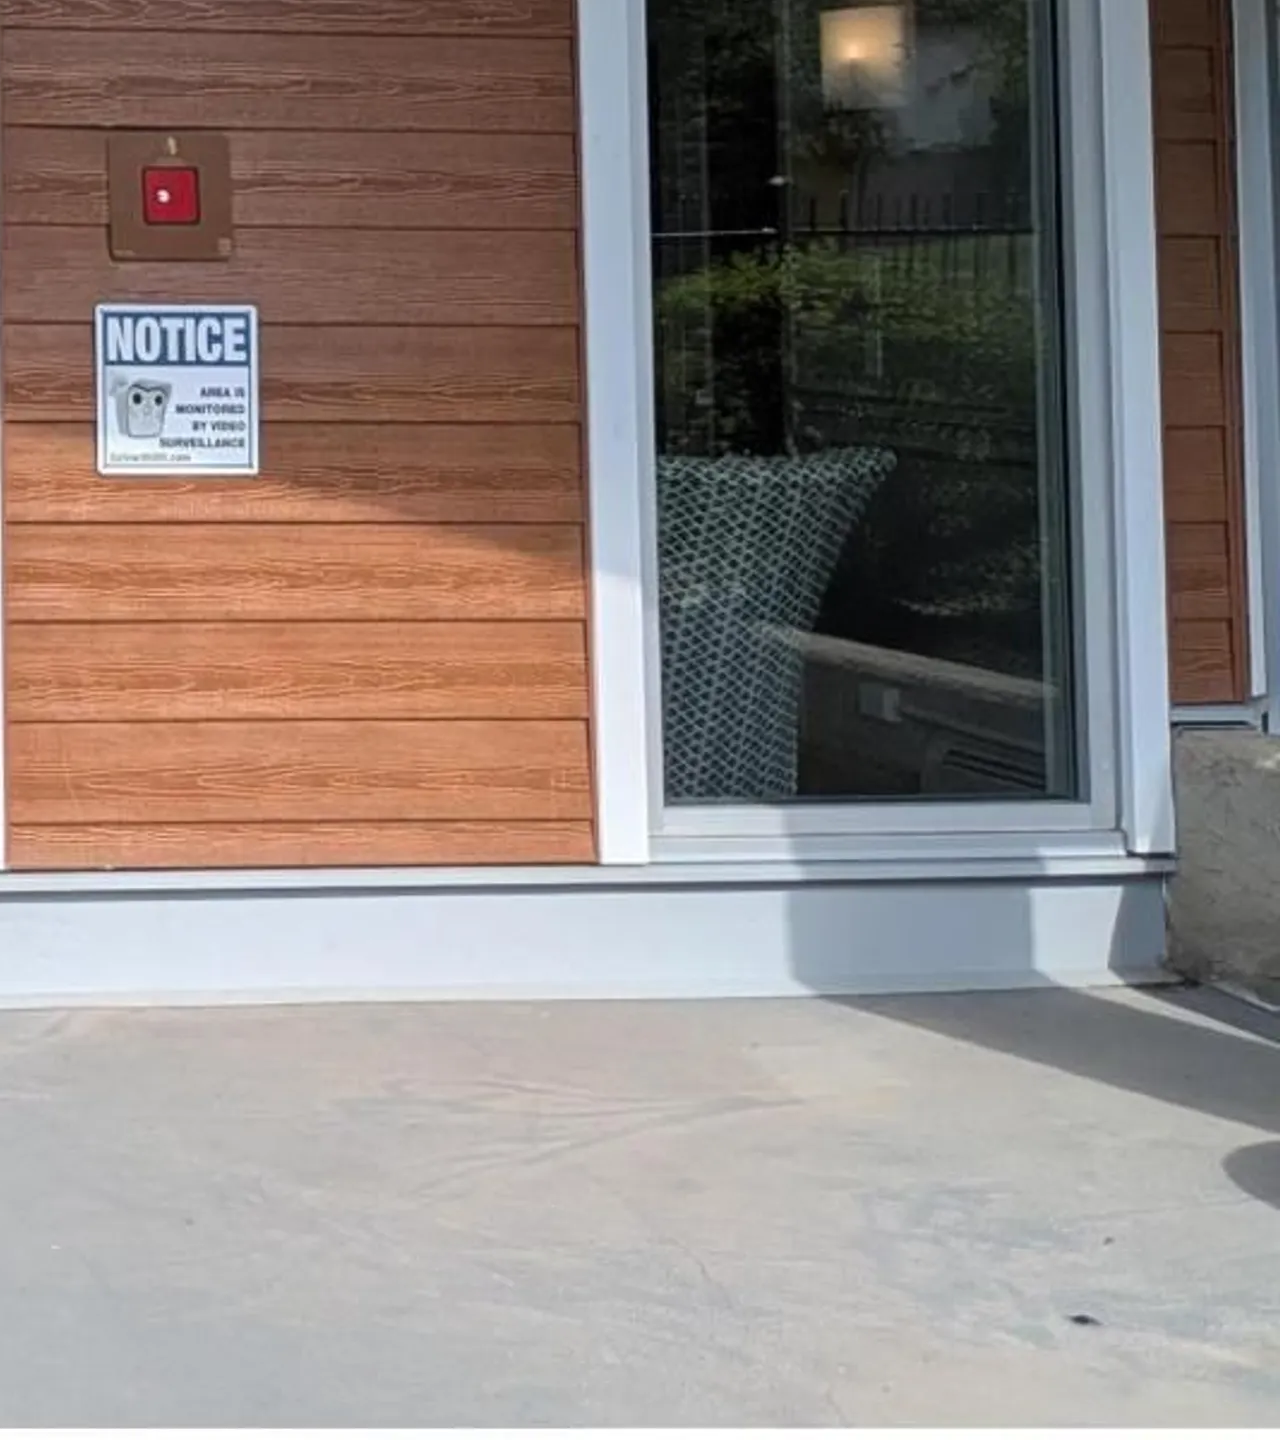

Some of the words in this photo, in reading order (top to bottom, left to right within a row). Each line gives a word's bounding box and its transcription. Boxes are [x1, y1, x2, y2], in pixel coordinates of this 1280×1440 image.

[106, 316, 248, 362] NOTICE
[175, 404, 245, 414] MONITORED
[211, 421, 246, 432] VIDEO
[159, 438, 245, 448] SURVEILLANCE
